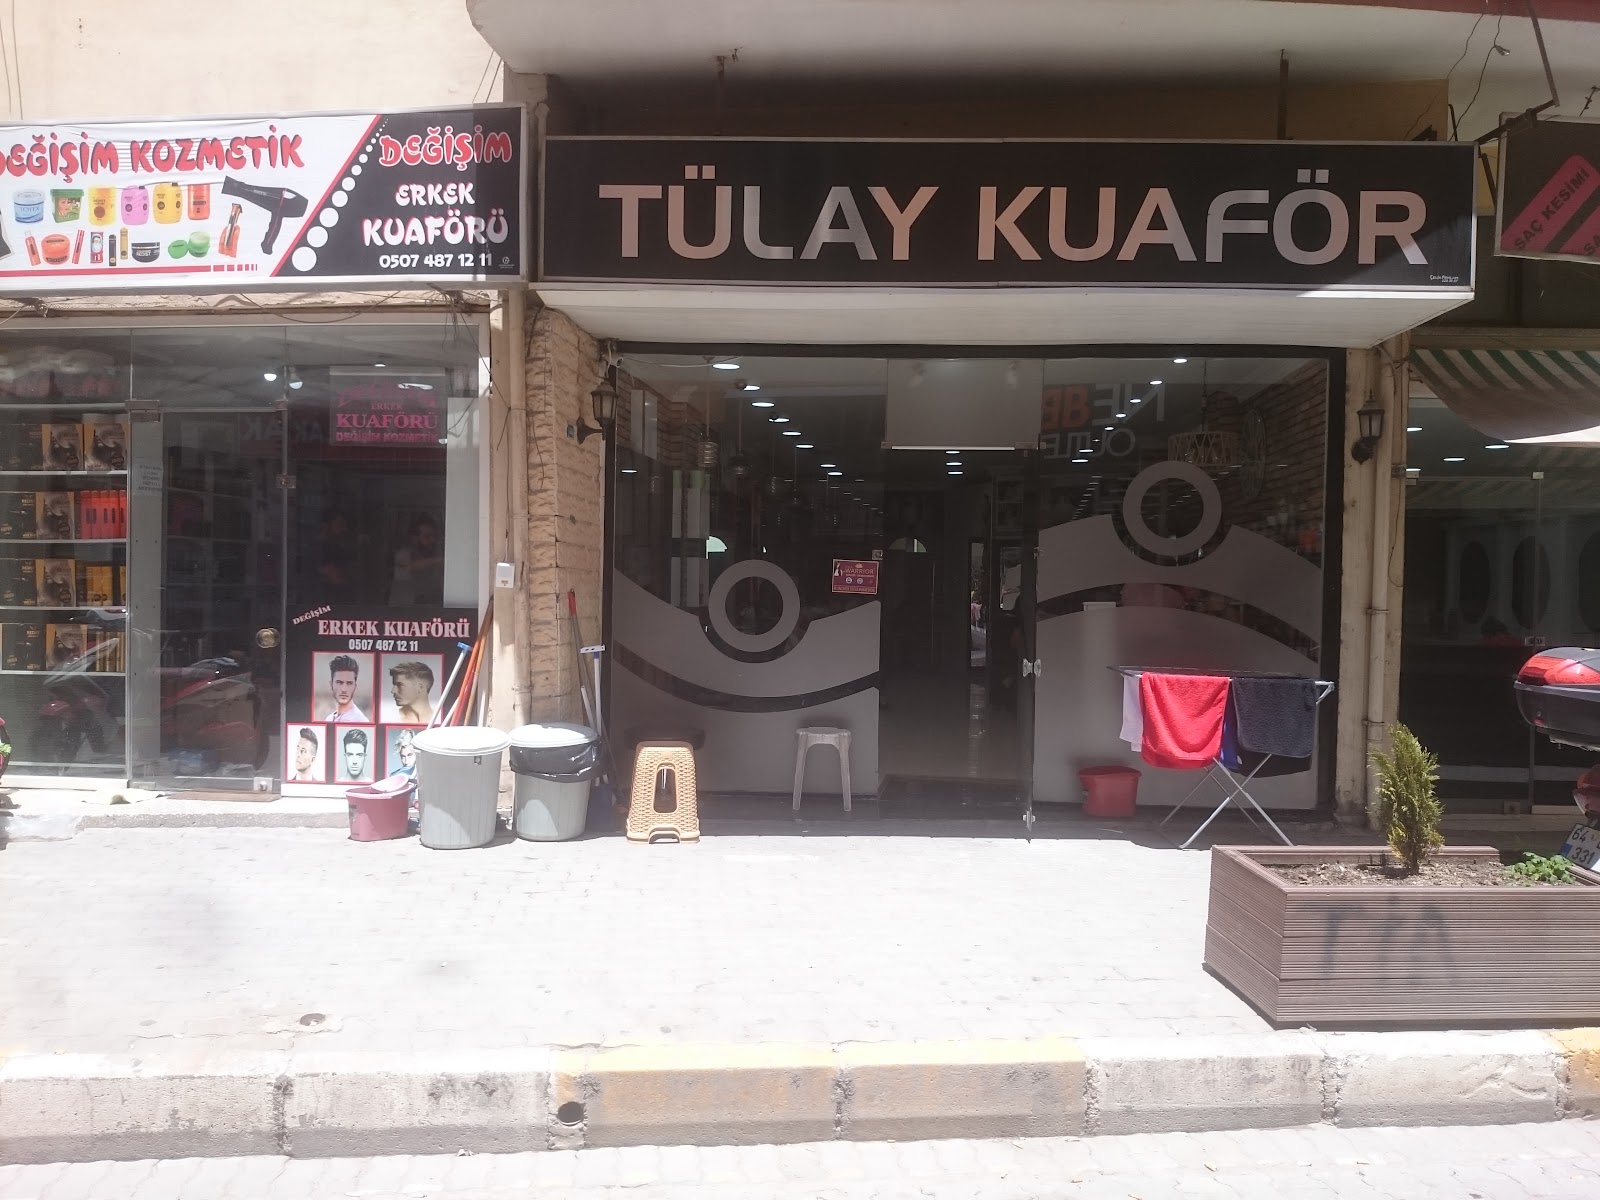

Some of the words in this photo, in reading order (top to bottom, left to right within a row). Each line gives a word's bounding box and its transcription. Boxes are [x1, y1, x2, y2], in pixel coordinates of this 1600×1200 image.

[0, 132, 119, 183] EĞİŞİM
[130, 124, 305, 173] KOZMETİK
[379, 125, 512, 171] DEĞİŞİM
[395, 182, 475, 206] ERKEK
[599, 165, 939, 260] TÜLAY
[977, 168, 1428, 265] KUAFÖR
[362, 208, 509, 246] KUAFÖRÜ
[379, 254, 419, 269] 0507
[424, 253, 453, 267] 487
[458, 253, 474, 267] 12
[479, 253, 492, 267] 11
[336, 411, 439, 429] KUAFÖRÜ
[292, 605, 331, 625] DEĞİŞİM
[318, 620, 379, 636] ERKEK
[384, 617, 470, 638] KUAFÖRÜ
[349, 638, 372, 650] 0507
[376, 640, 393, 651] 487
[397, 640, 407, 651] 12
[409, 641, 418, 651] 11
[1572, 827, 1588, 842] 64
[1572, 846, 1595, 864] 331
